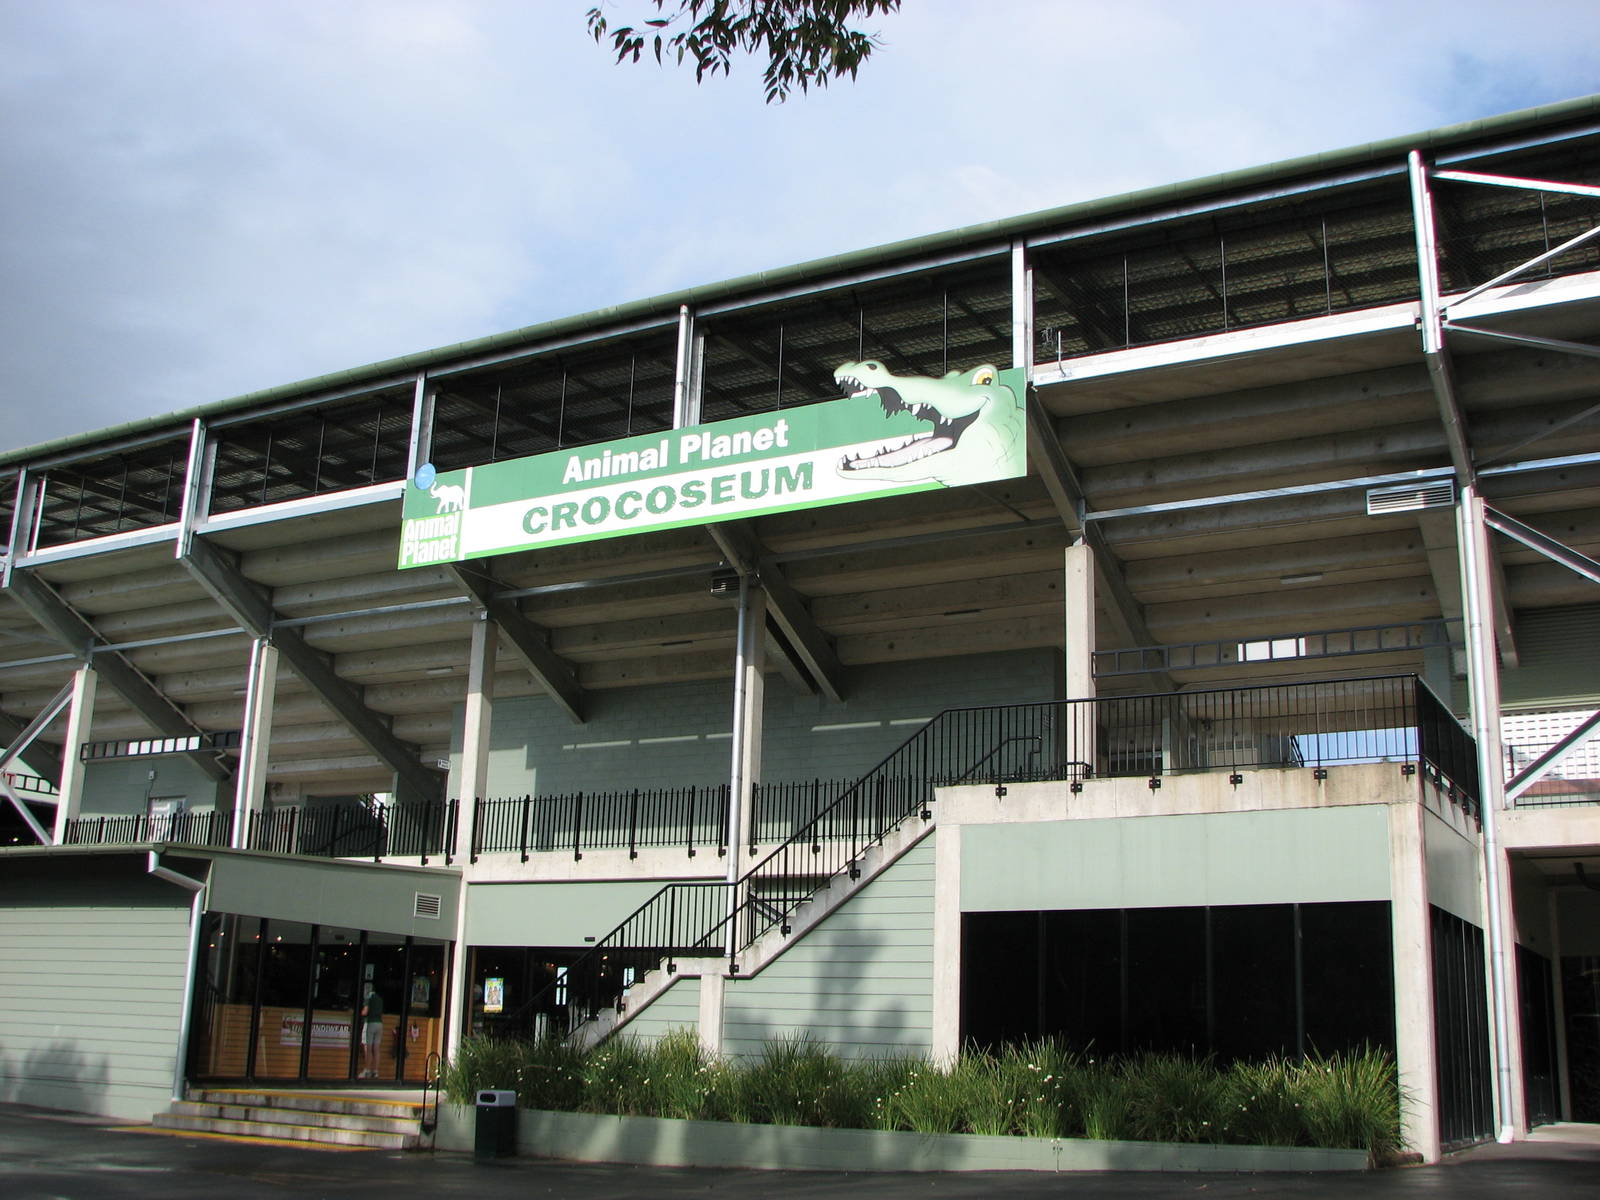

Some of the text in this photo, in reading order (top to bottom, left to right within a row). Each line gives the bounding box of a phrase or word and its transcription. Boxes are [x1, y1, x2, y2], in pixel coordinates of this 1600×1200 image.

[562, 418, 789, 484] Animal Planet
[522, 461, 814, 534] CROCOSEUM
[401, 535, 458, 566] Planet
[403, 511, 461, 542] Animal
